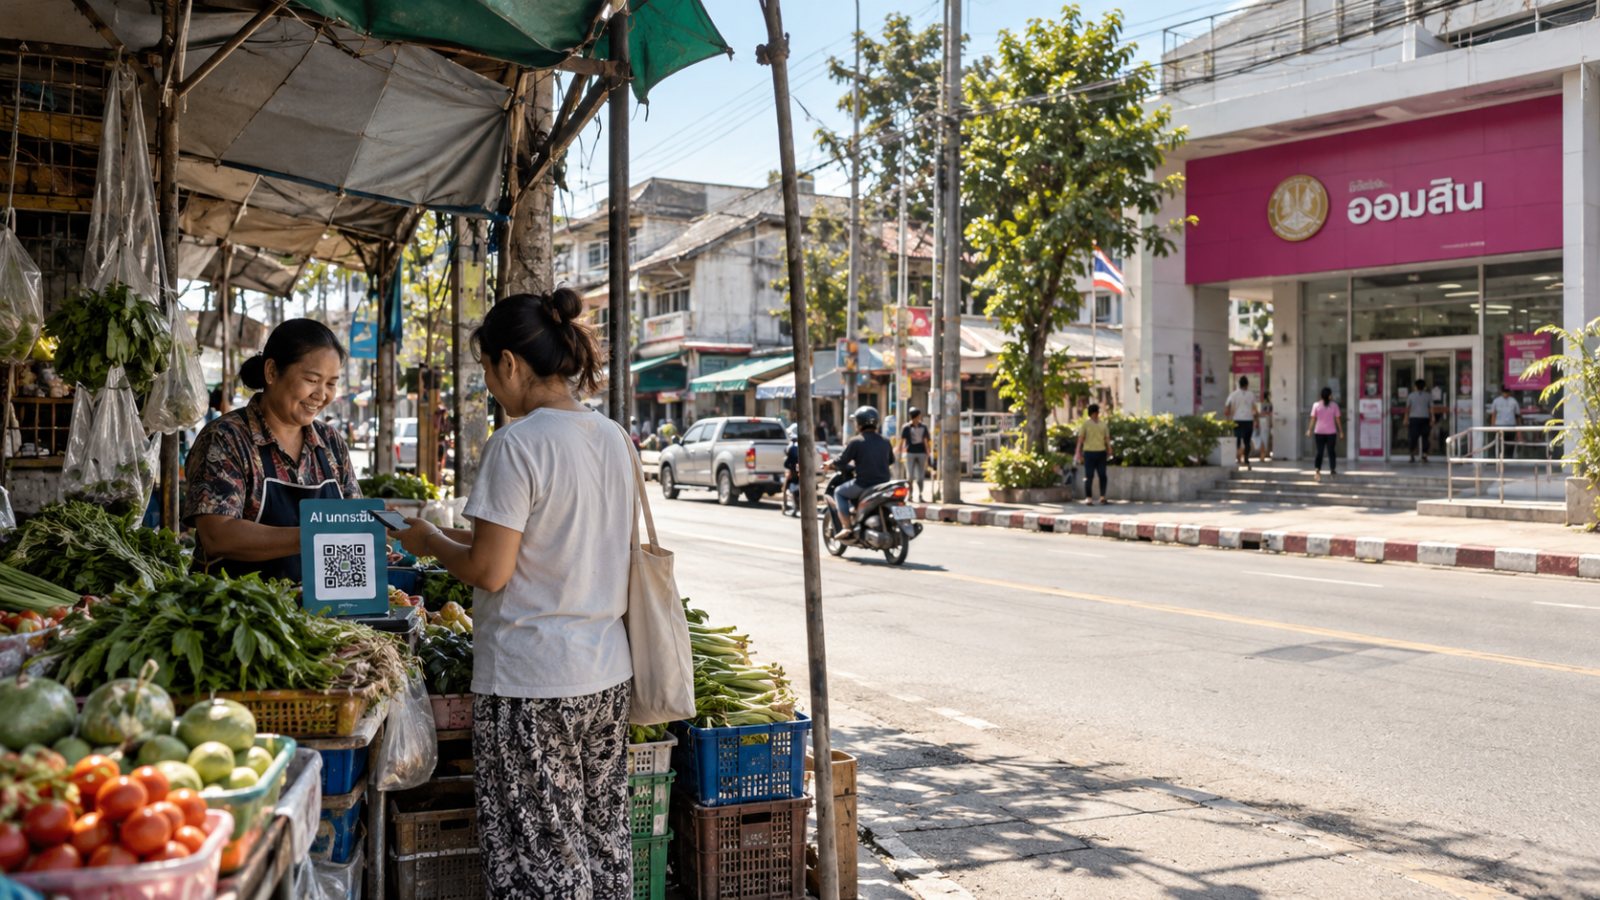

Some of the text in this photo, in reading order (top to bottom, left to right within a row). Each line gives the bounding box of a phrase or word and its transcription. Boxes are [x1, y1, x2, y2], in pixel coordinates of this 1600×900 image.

[1347, 177, 1483, 224] ออมสิน
[310, 511, 323, 523] AI
